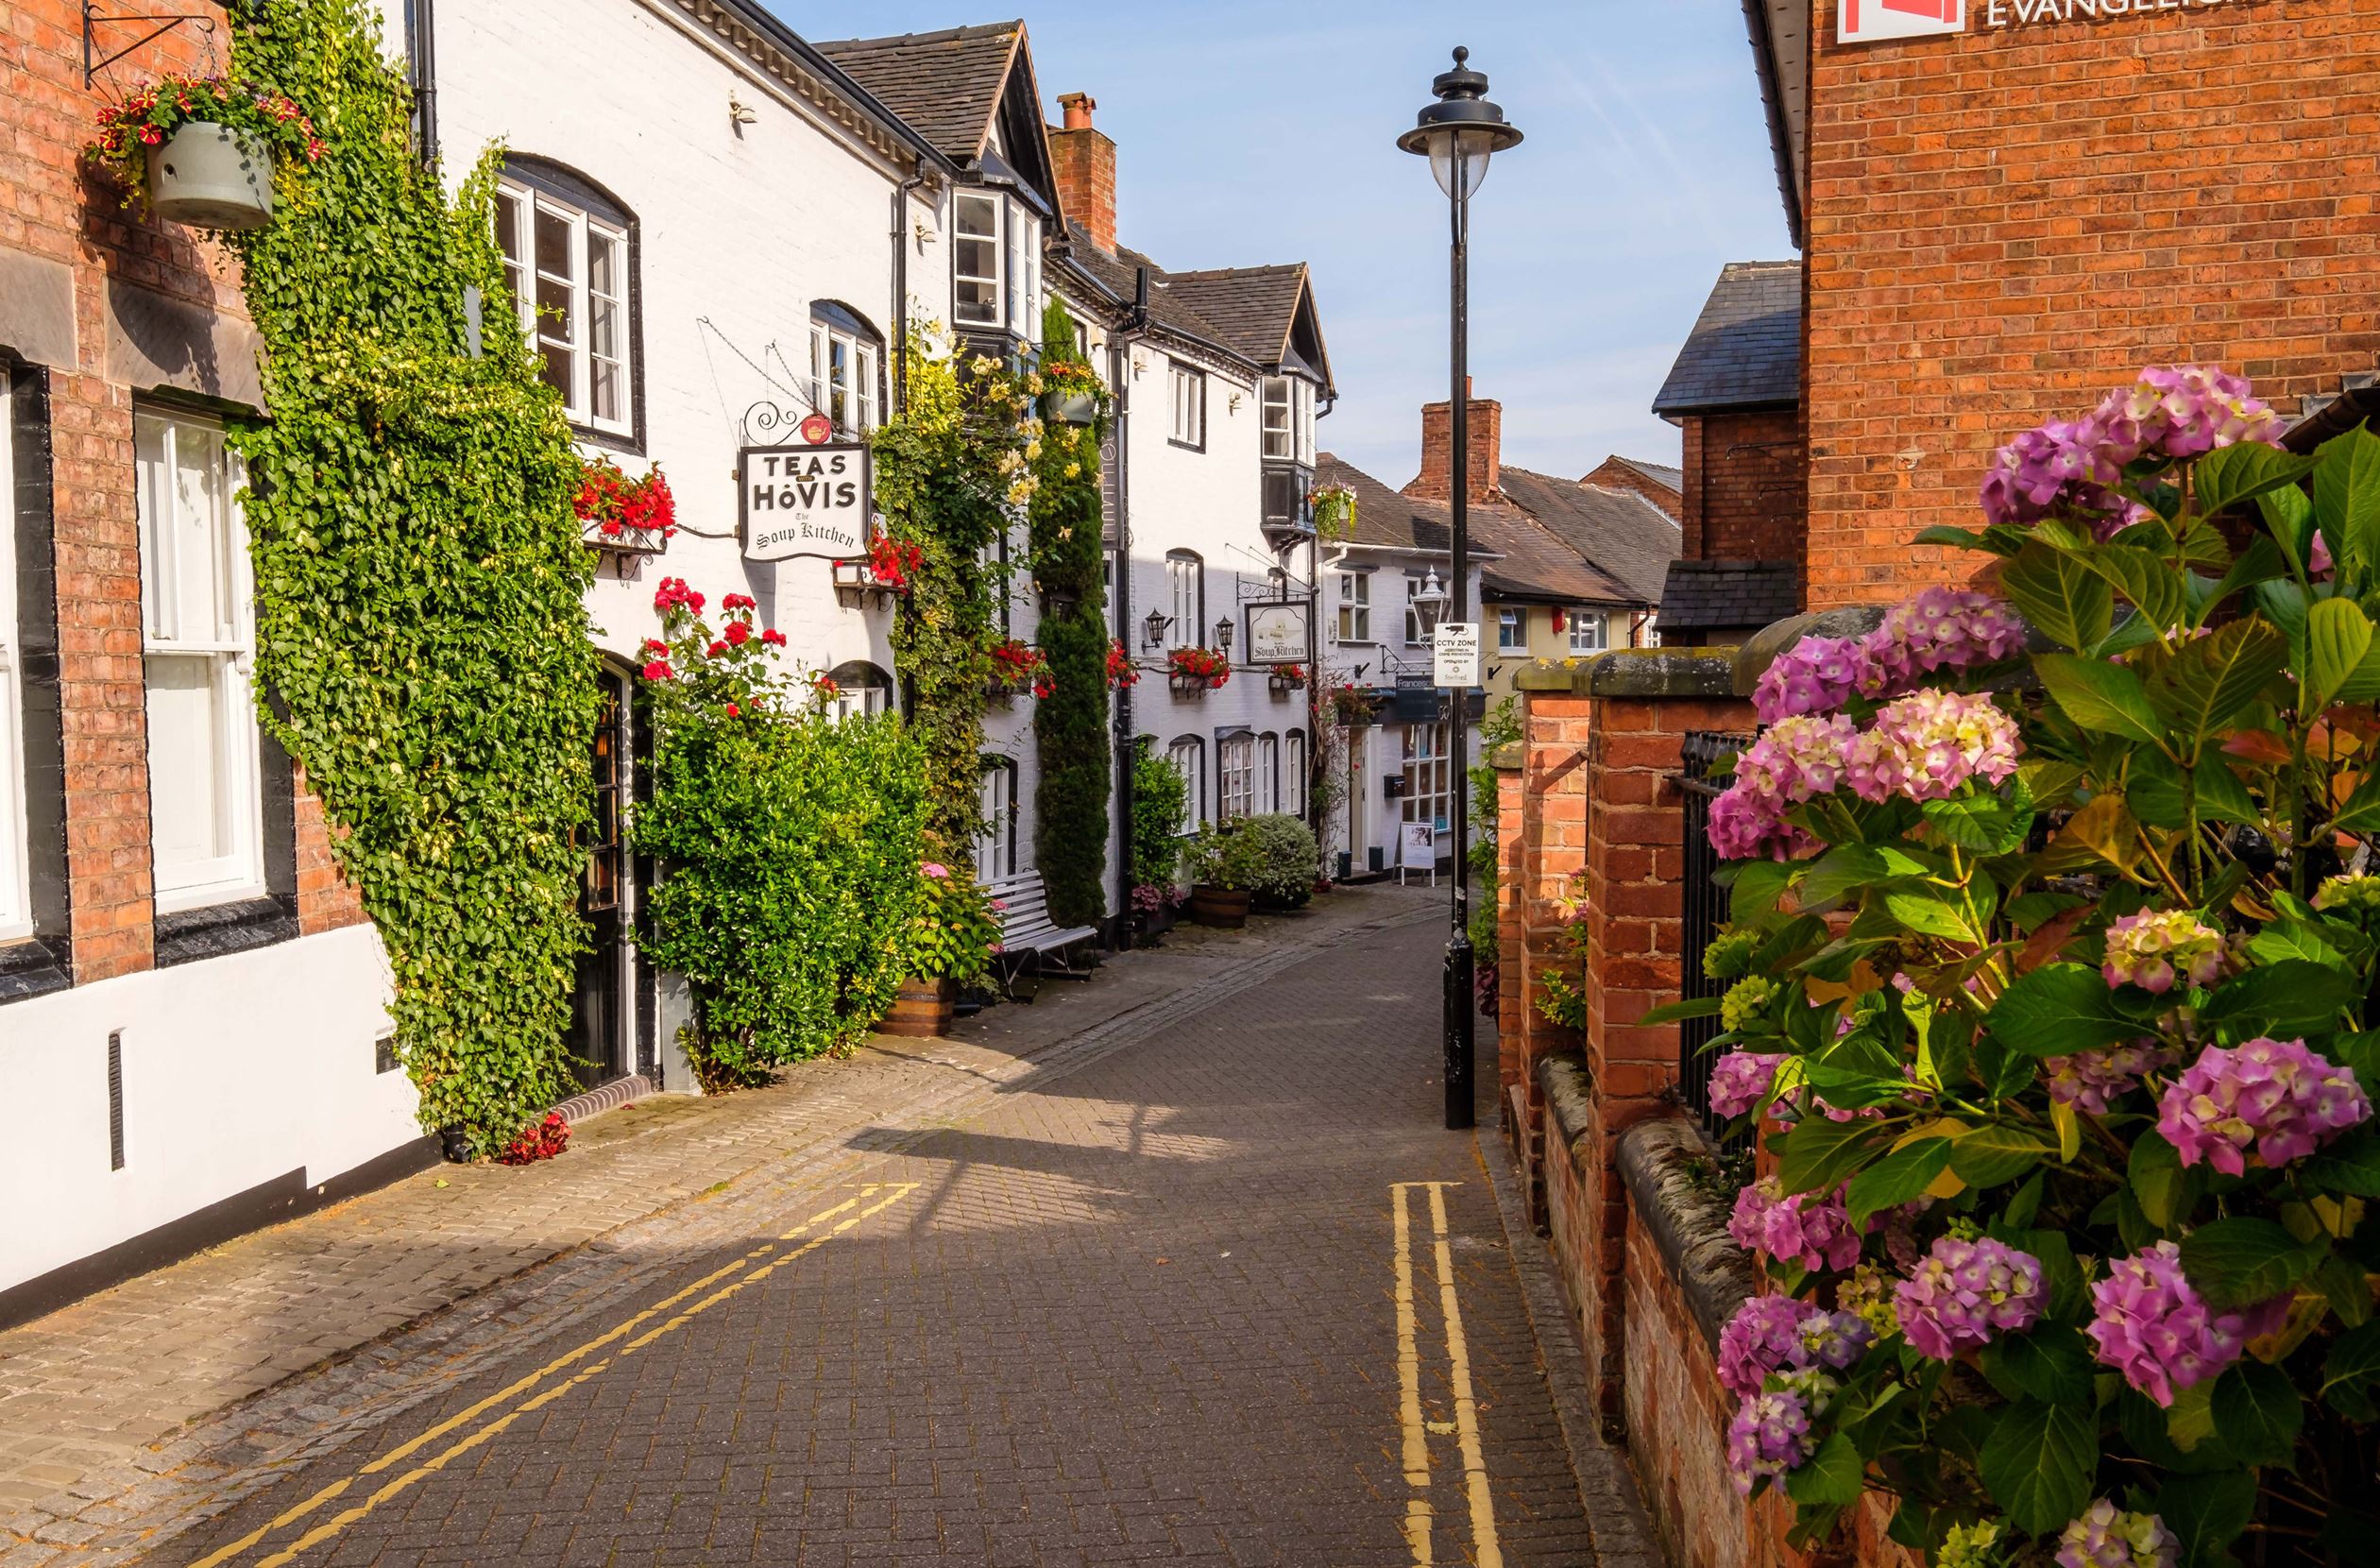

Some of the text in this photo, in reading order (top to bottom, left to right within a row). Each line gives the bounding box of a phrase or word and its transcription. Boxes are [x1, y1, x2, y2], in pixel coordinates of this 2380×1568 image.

[763, 455, 846, 477] TEAS
[756, 522, 855, 550] Soup Kitchen
[1255, 645, 1304, 658] Soup Kitchen
